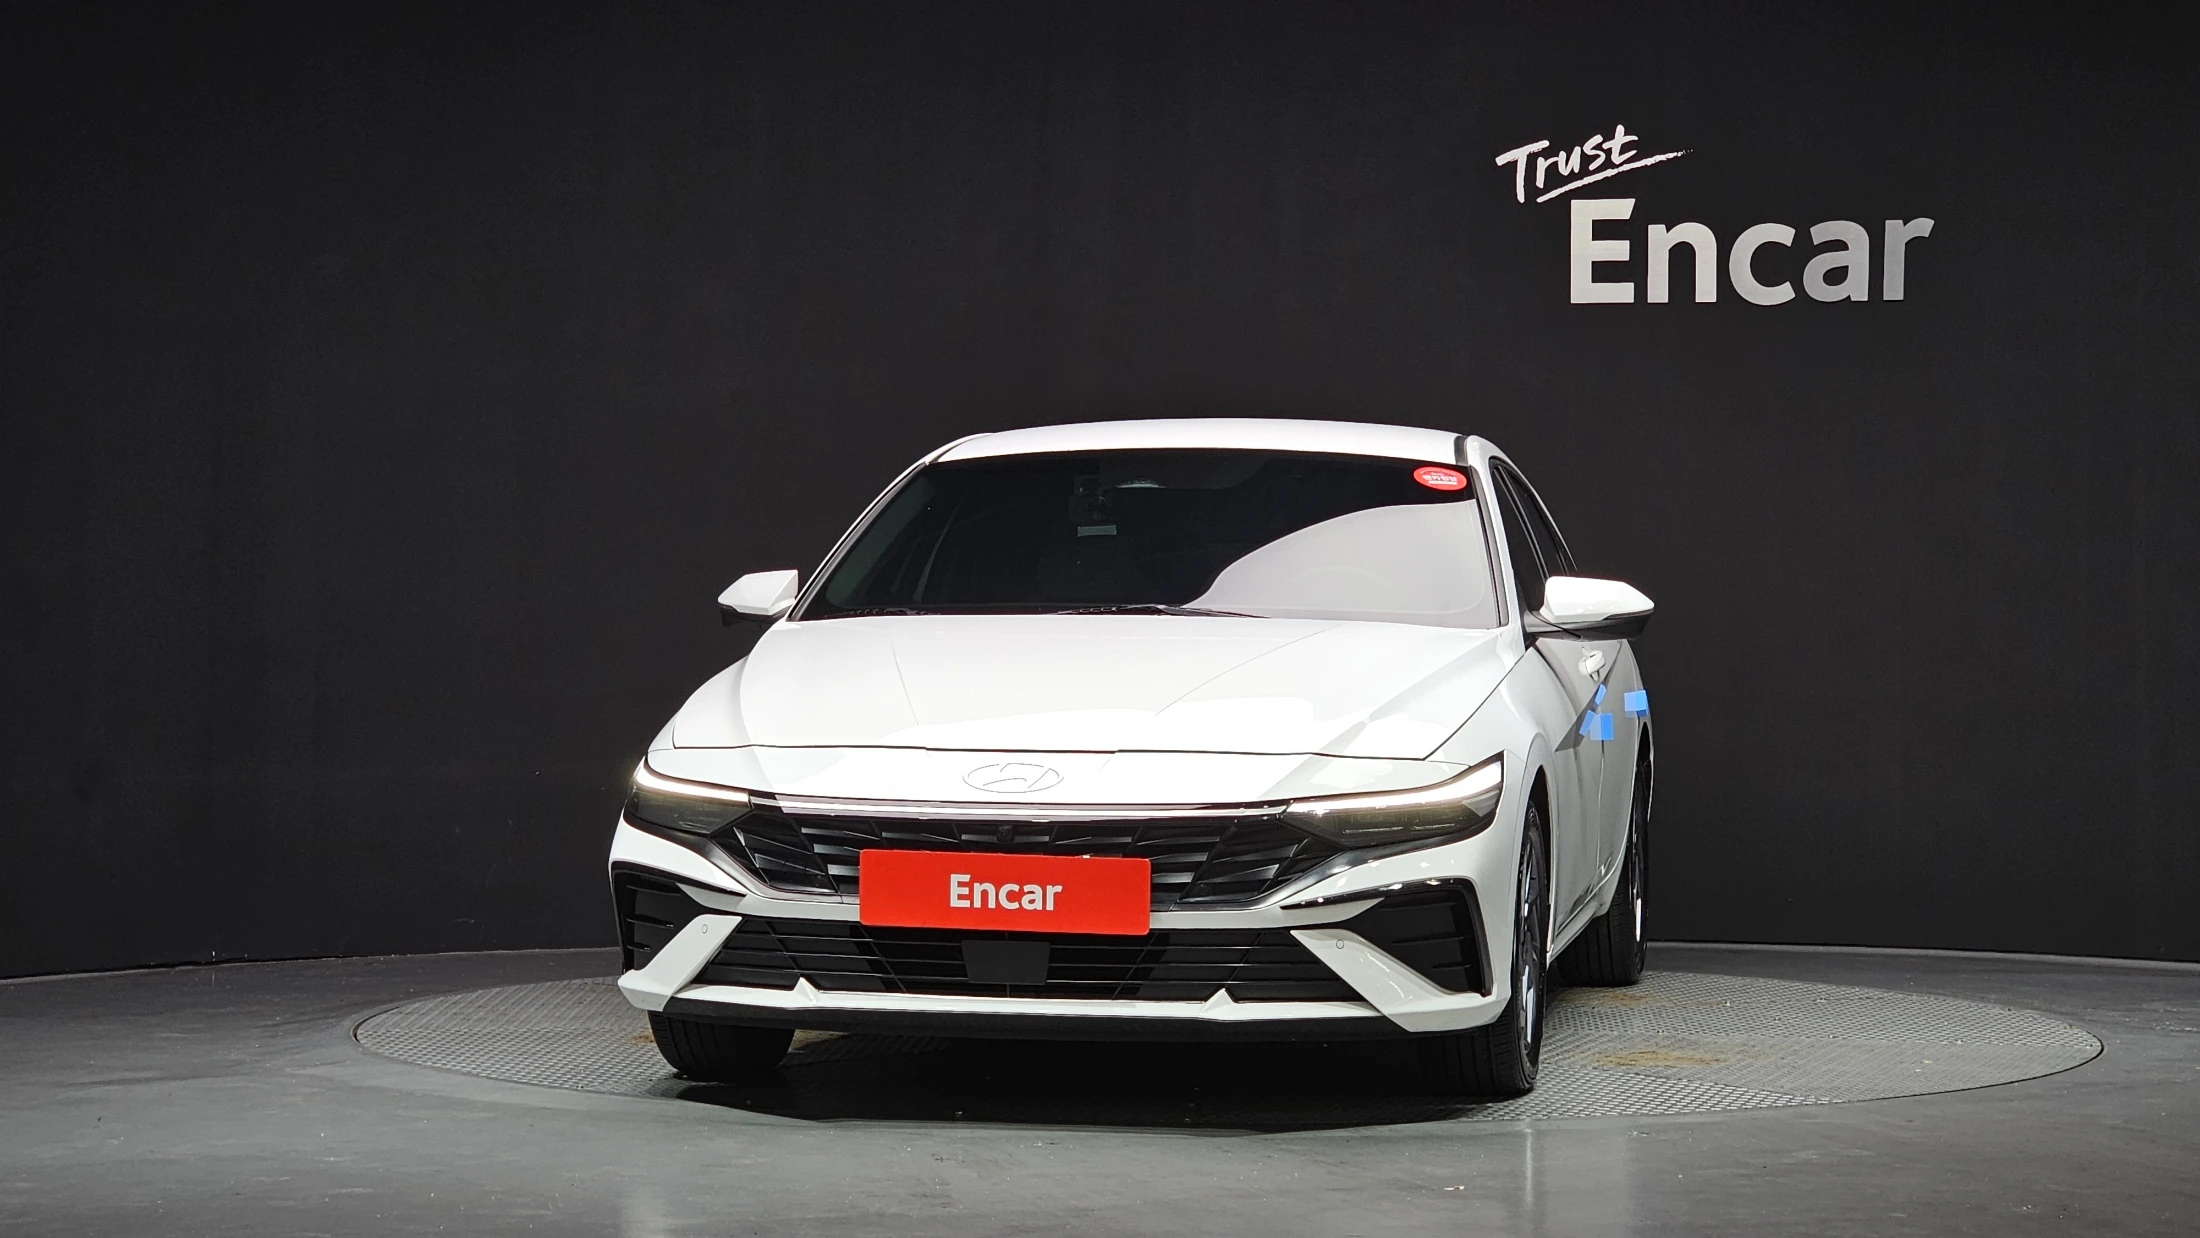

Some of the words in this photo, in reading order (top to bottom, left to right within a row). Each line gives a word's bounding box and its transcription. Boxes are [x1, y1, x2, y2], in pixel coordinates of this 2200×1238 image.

[1495, 124, 1639, 203] Trust
[1570, 198, 1935, 306] Encar
[949, 873, 1063, 911] Encar
